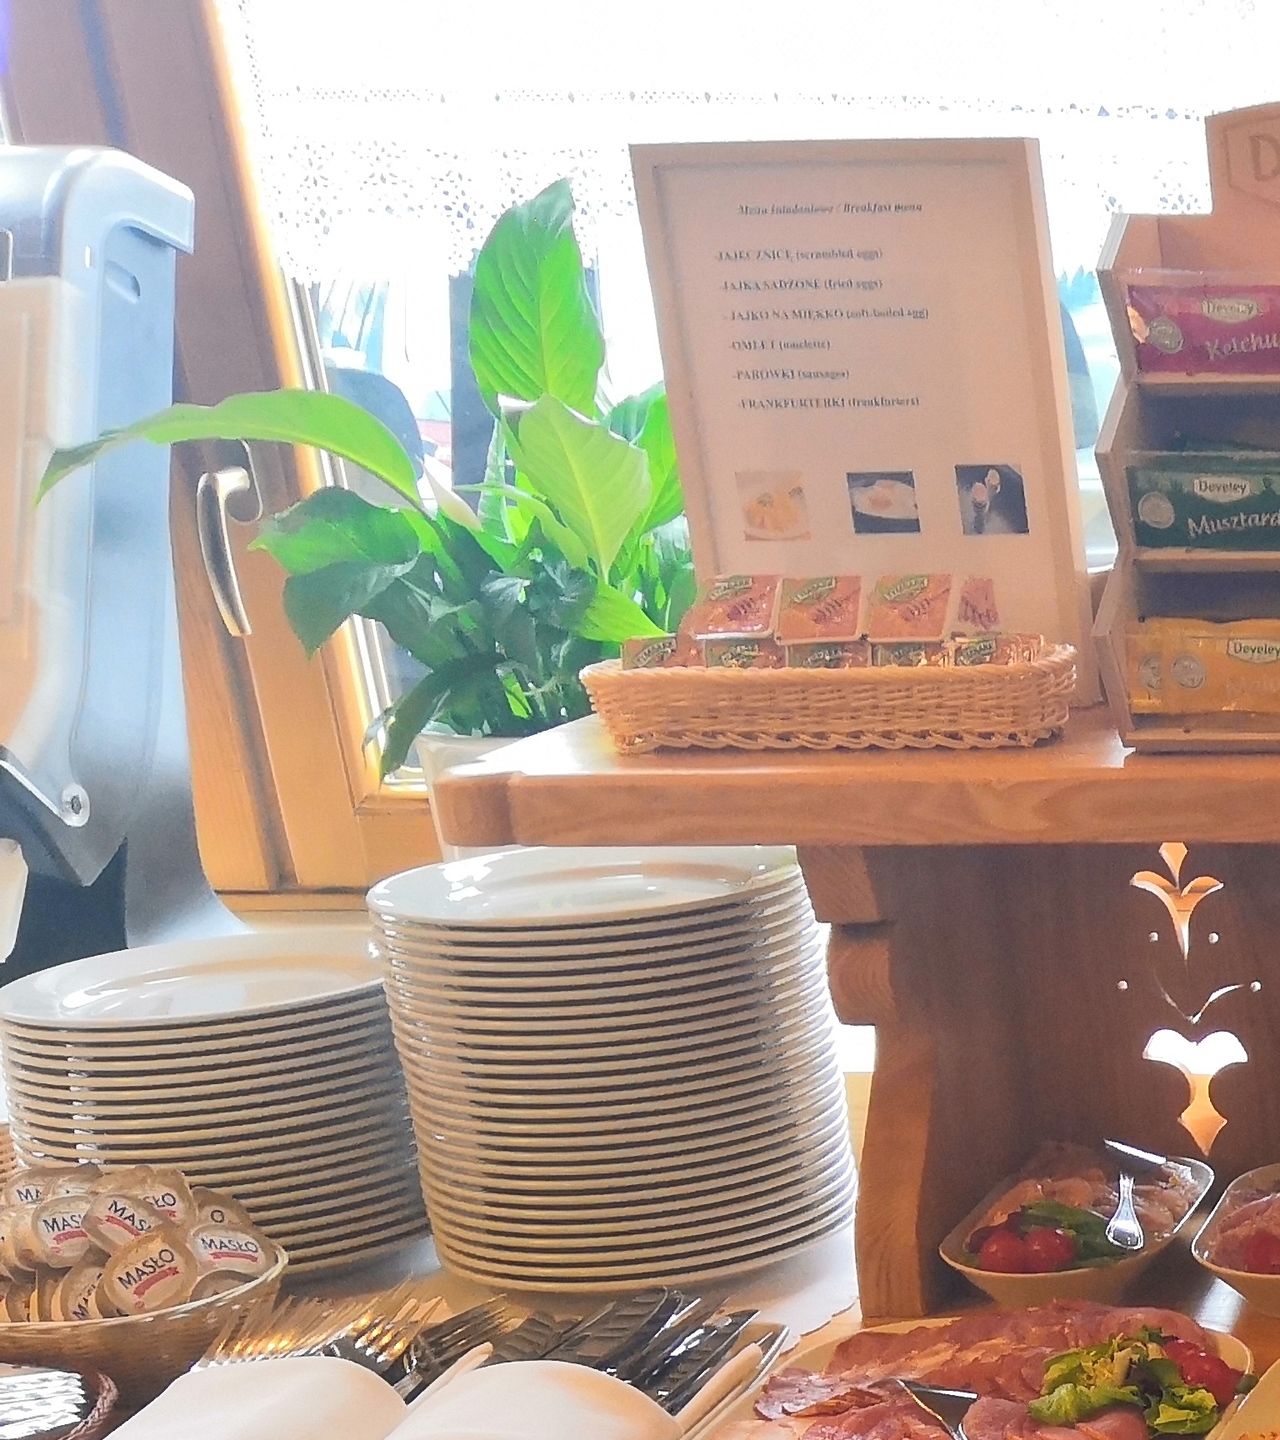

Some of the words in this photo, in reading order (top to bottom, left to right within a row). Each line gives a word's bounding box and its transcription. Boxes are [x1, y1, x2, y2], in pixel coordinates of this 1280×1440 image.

[1199, 481, 1248, 494] Develey
[42, 1214, 83, 1233] MAS
[107, 1200, 152, 1232] MAS
[201, 1237, 258, 1253] MASŁO
[117, 1248, 174, 1289] MASŁO
